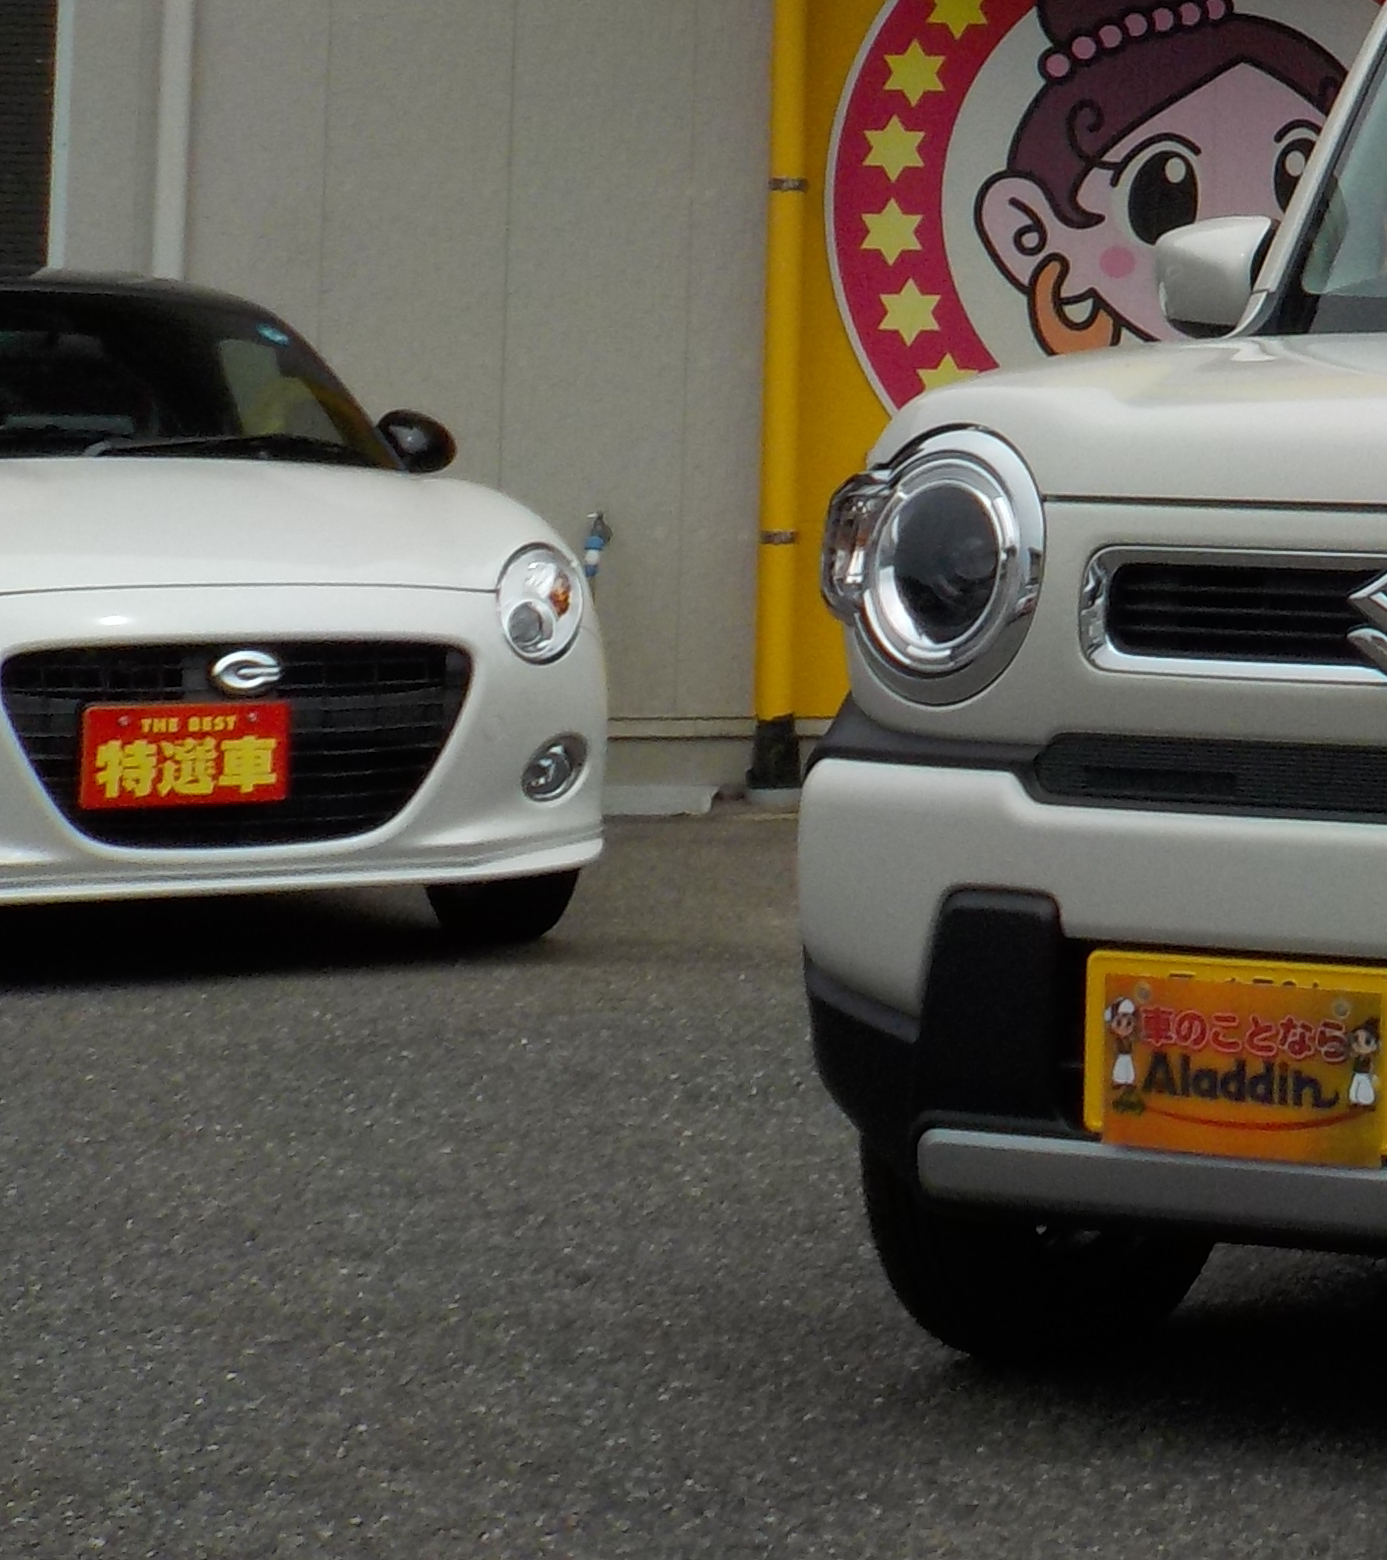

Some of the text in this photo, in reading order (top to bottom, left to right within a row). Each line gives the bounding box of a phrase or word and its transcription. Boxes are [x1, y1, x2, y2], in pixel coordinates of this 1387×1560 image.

[140, 715, 236, 733] THE BEST
[96, 735, 276, 798] 特選車
[1139, 1005, 1348, 1063] 車のことなら
[1143, 1051, 1339, 1109] Aladdin
